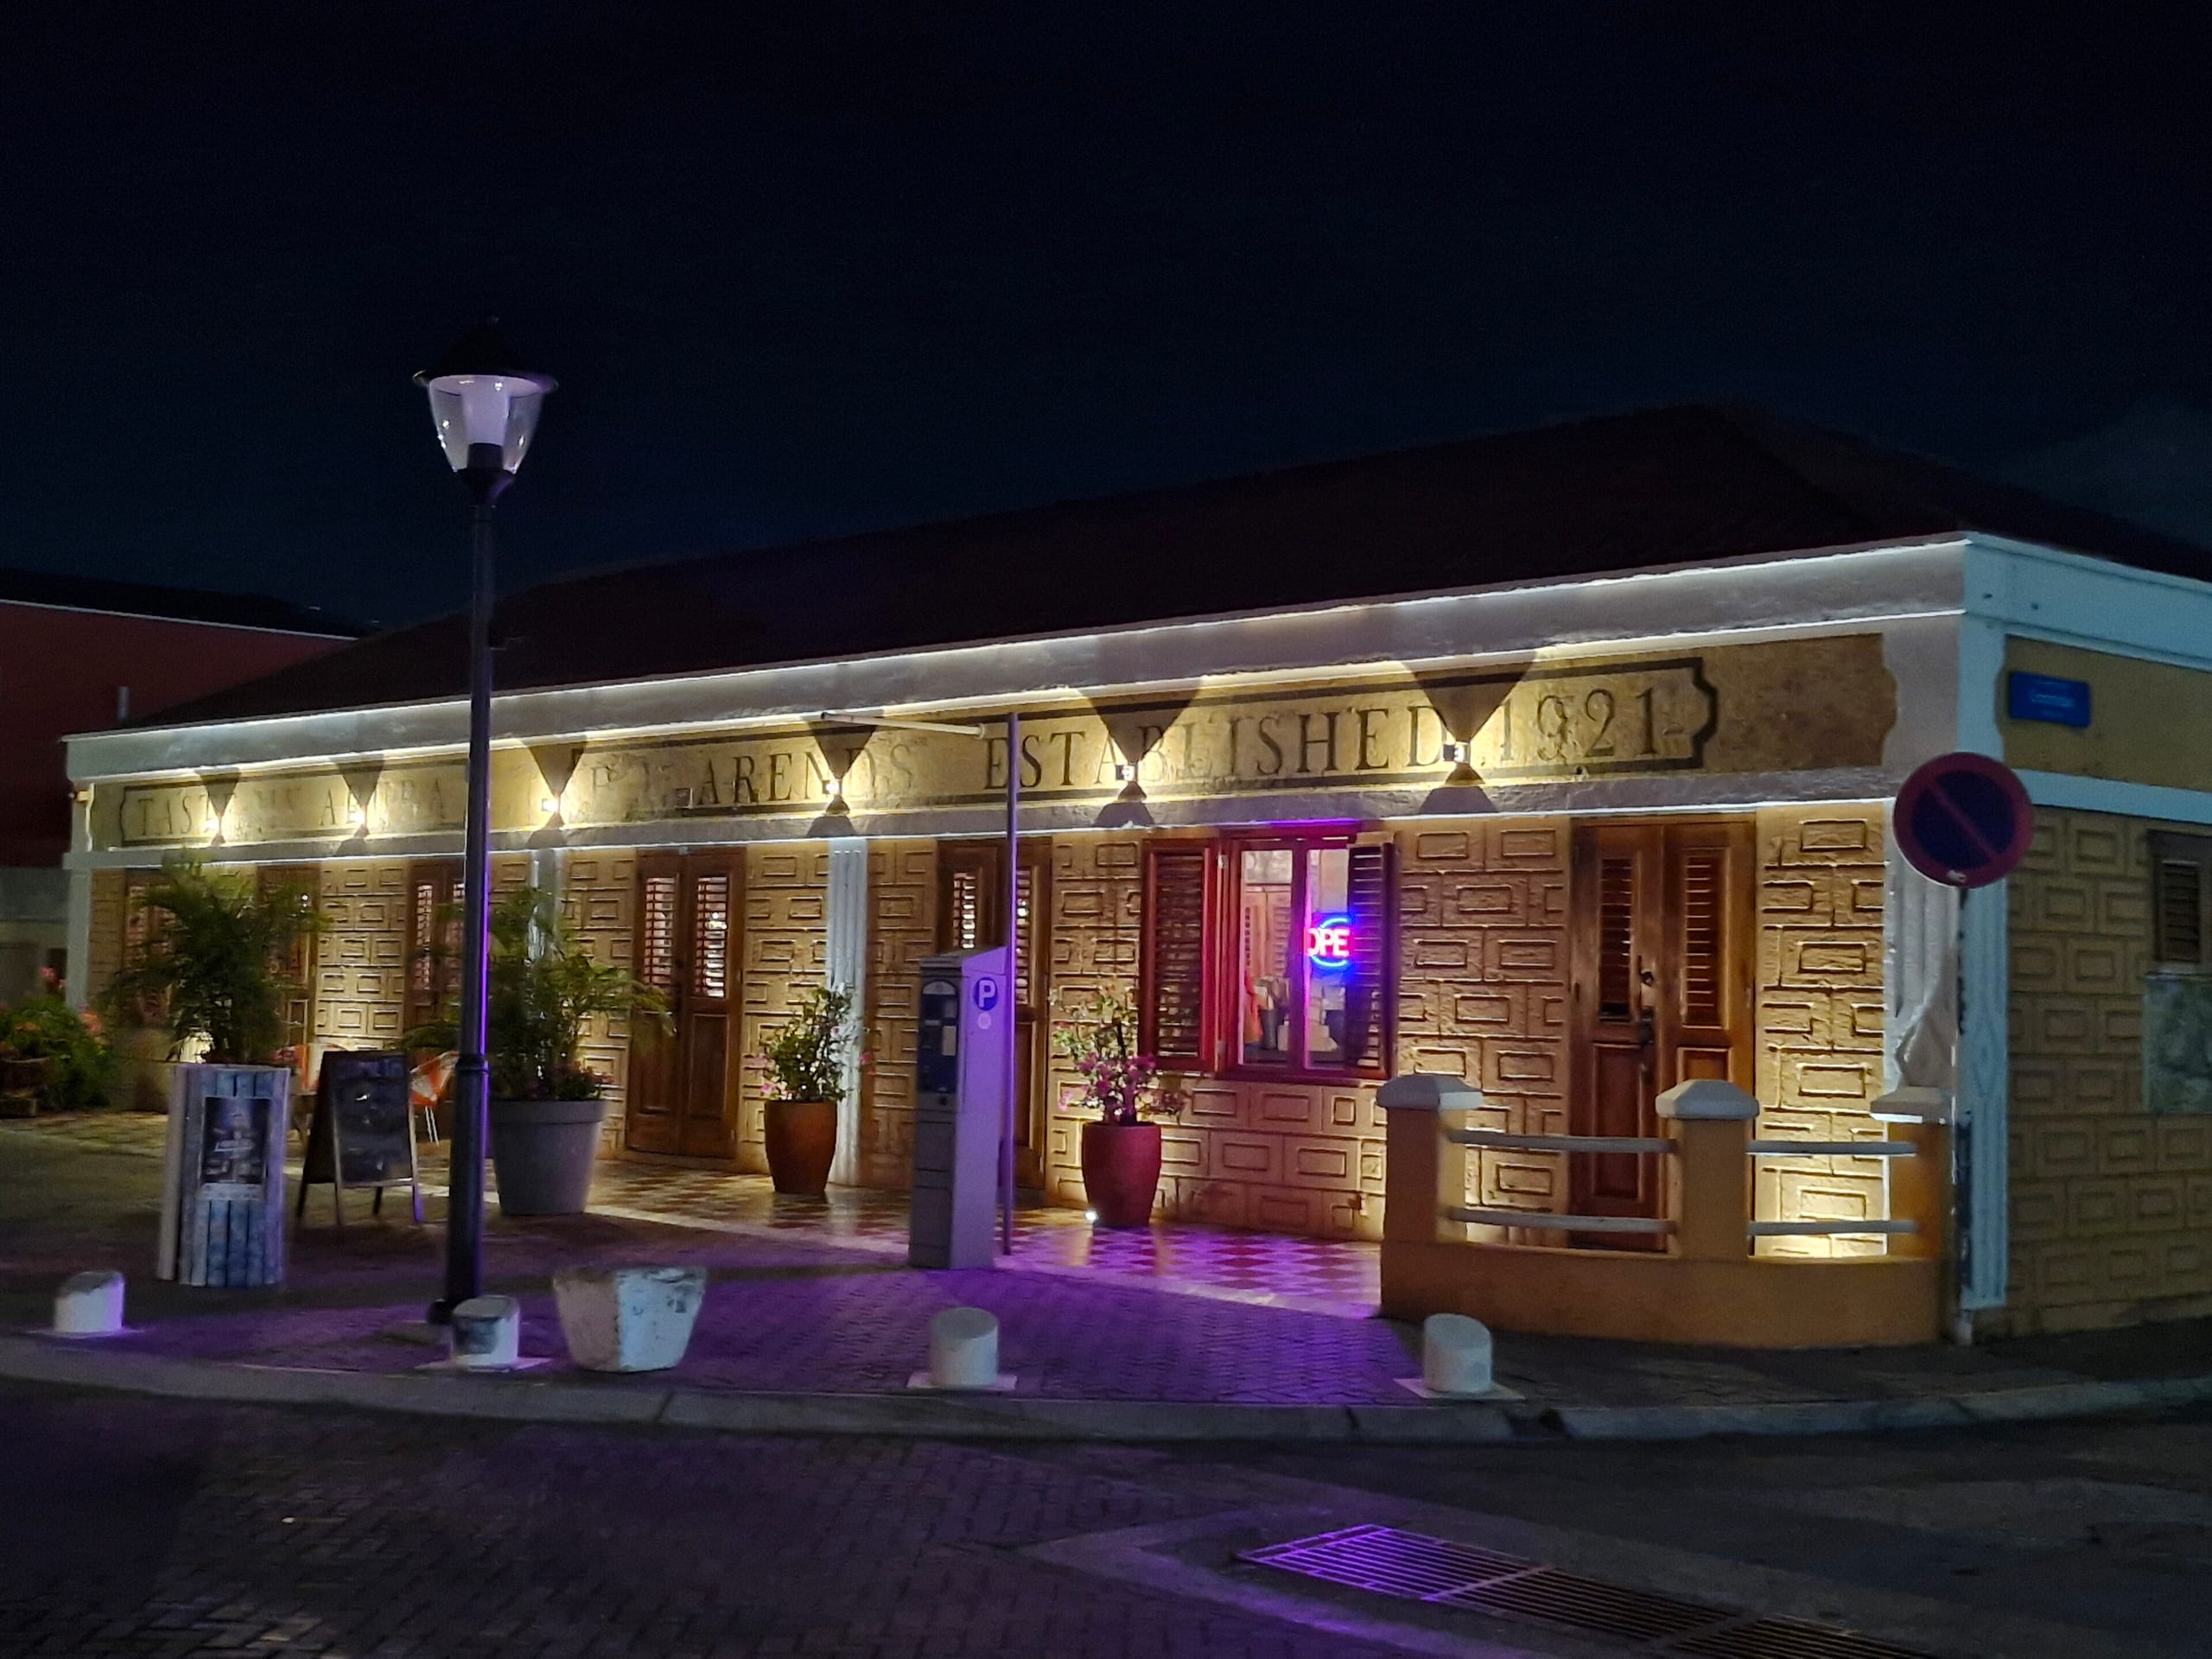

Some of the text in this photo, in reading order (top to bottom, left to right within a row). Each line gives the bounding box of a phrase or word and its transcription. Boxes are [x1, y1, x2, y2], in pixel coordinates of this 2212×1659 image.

[984, 705, 1447, 791] ESTABLISHED
[1498, 688, 1660, 763] 1921
[1306, 926, 1351, 957] OPE
[978, 979, 996, 1007] P
